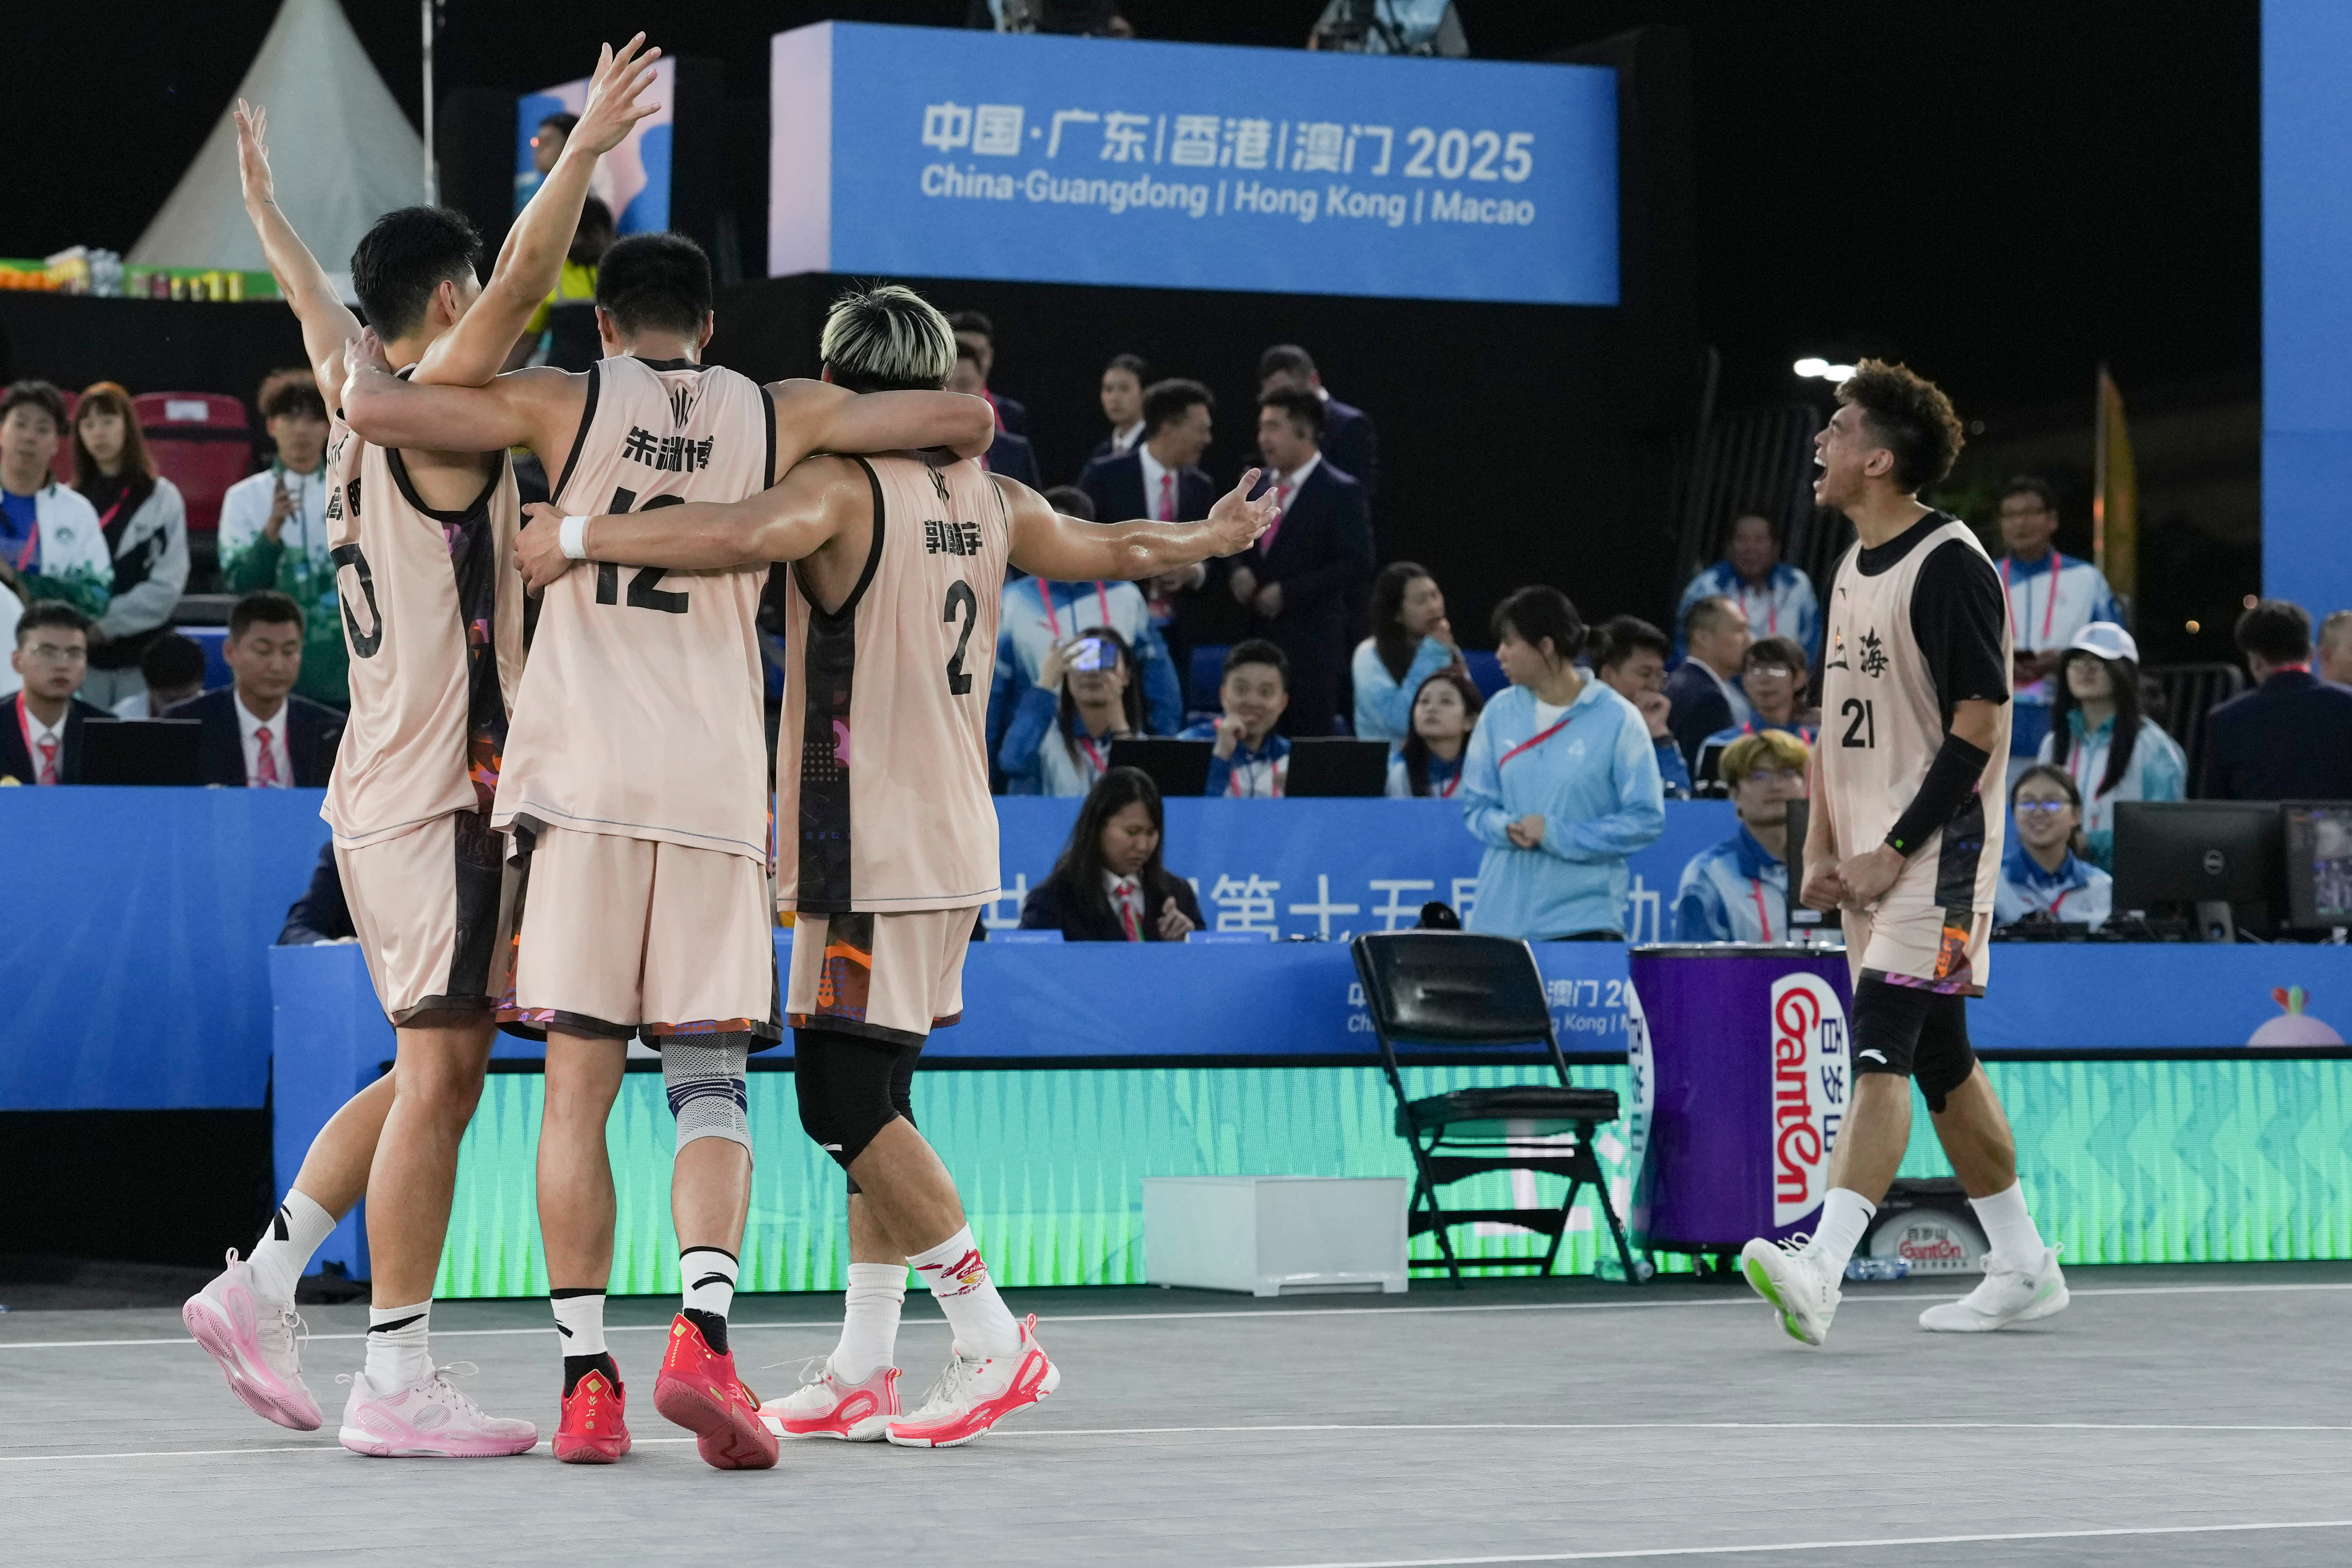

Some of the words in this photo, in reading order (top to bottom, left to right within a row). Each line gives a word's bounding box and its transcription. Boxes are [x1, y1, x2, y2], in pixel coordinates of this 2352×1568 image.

[1404, 127, 1534, 183] 2025
[1235, 179, 1318, 224] Hong
[1326, 185, 1405, 228] Kong
[1431, 190, 1535, 226] Macao
[943, 579, 977, 695] 2
[1827, 625, 1889, 678] 上海
[1841, 697, 1875, 749] 21
